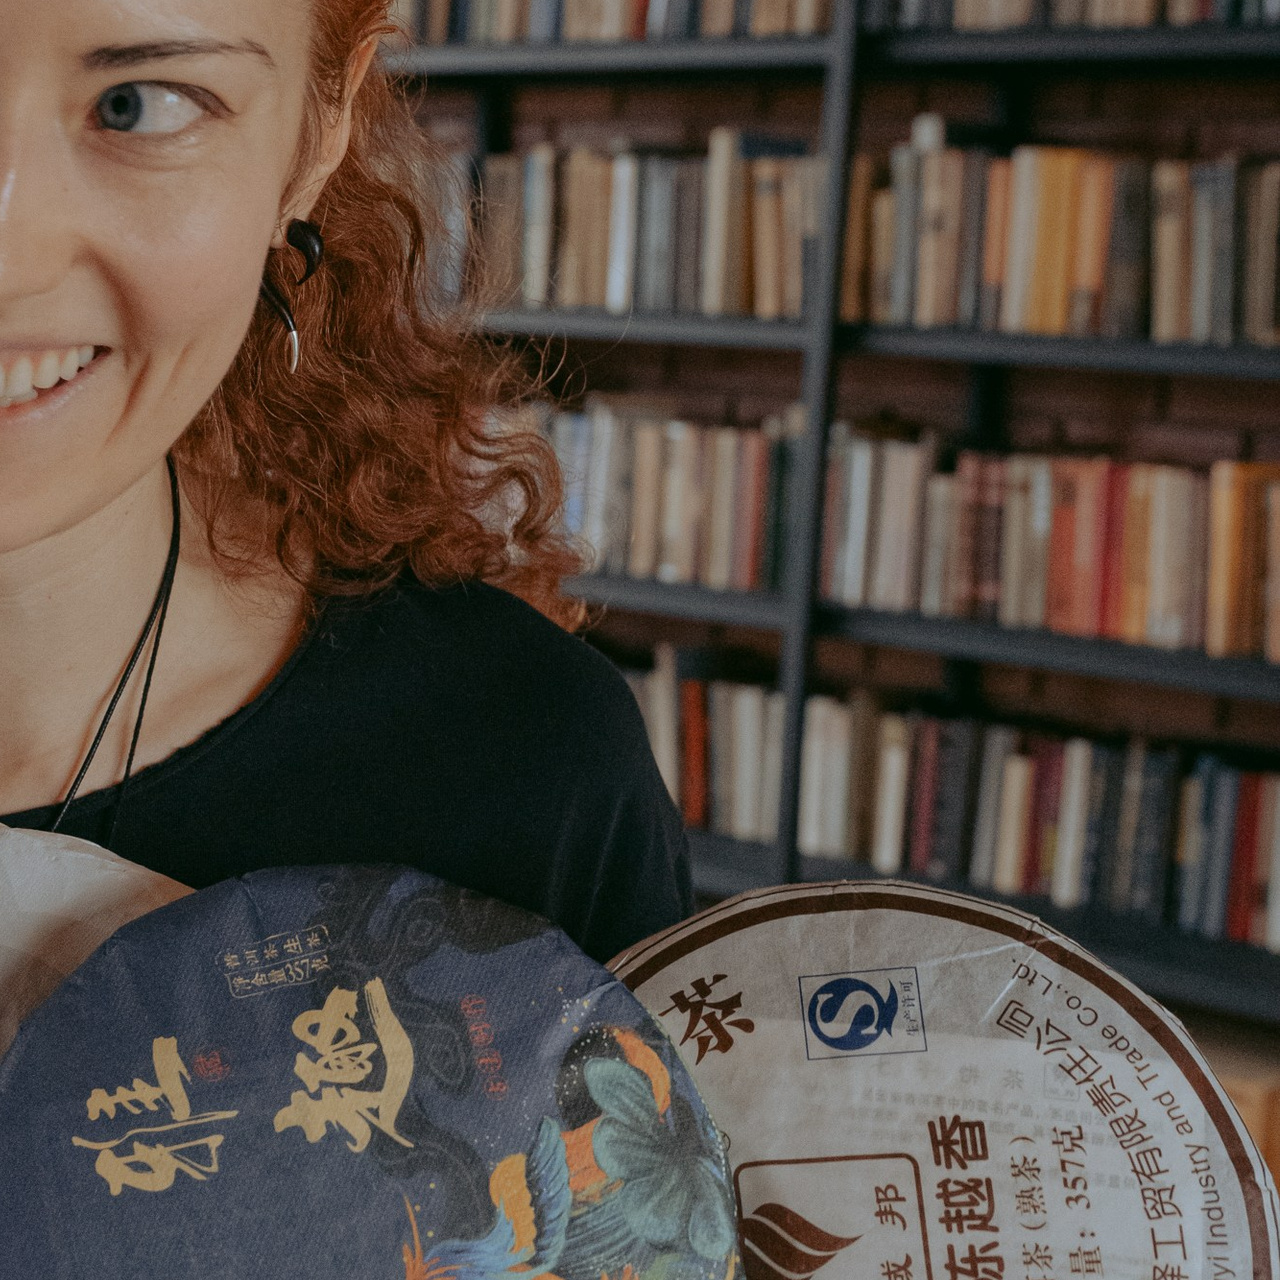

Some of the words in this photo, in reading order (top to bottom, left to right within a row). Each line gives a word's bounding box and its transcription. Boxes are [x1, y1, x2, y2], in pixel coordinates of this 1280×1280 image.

[658, 974, 756, 1066] 茶
[1102, 1025, 1158, 1091] Trade
[1153, 1091, 1193, 1135] and
[1184, 1143, 1229, 1246] Industry
